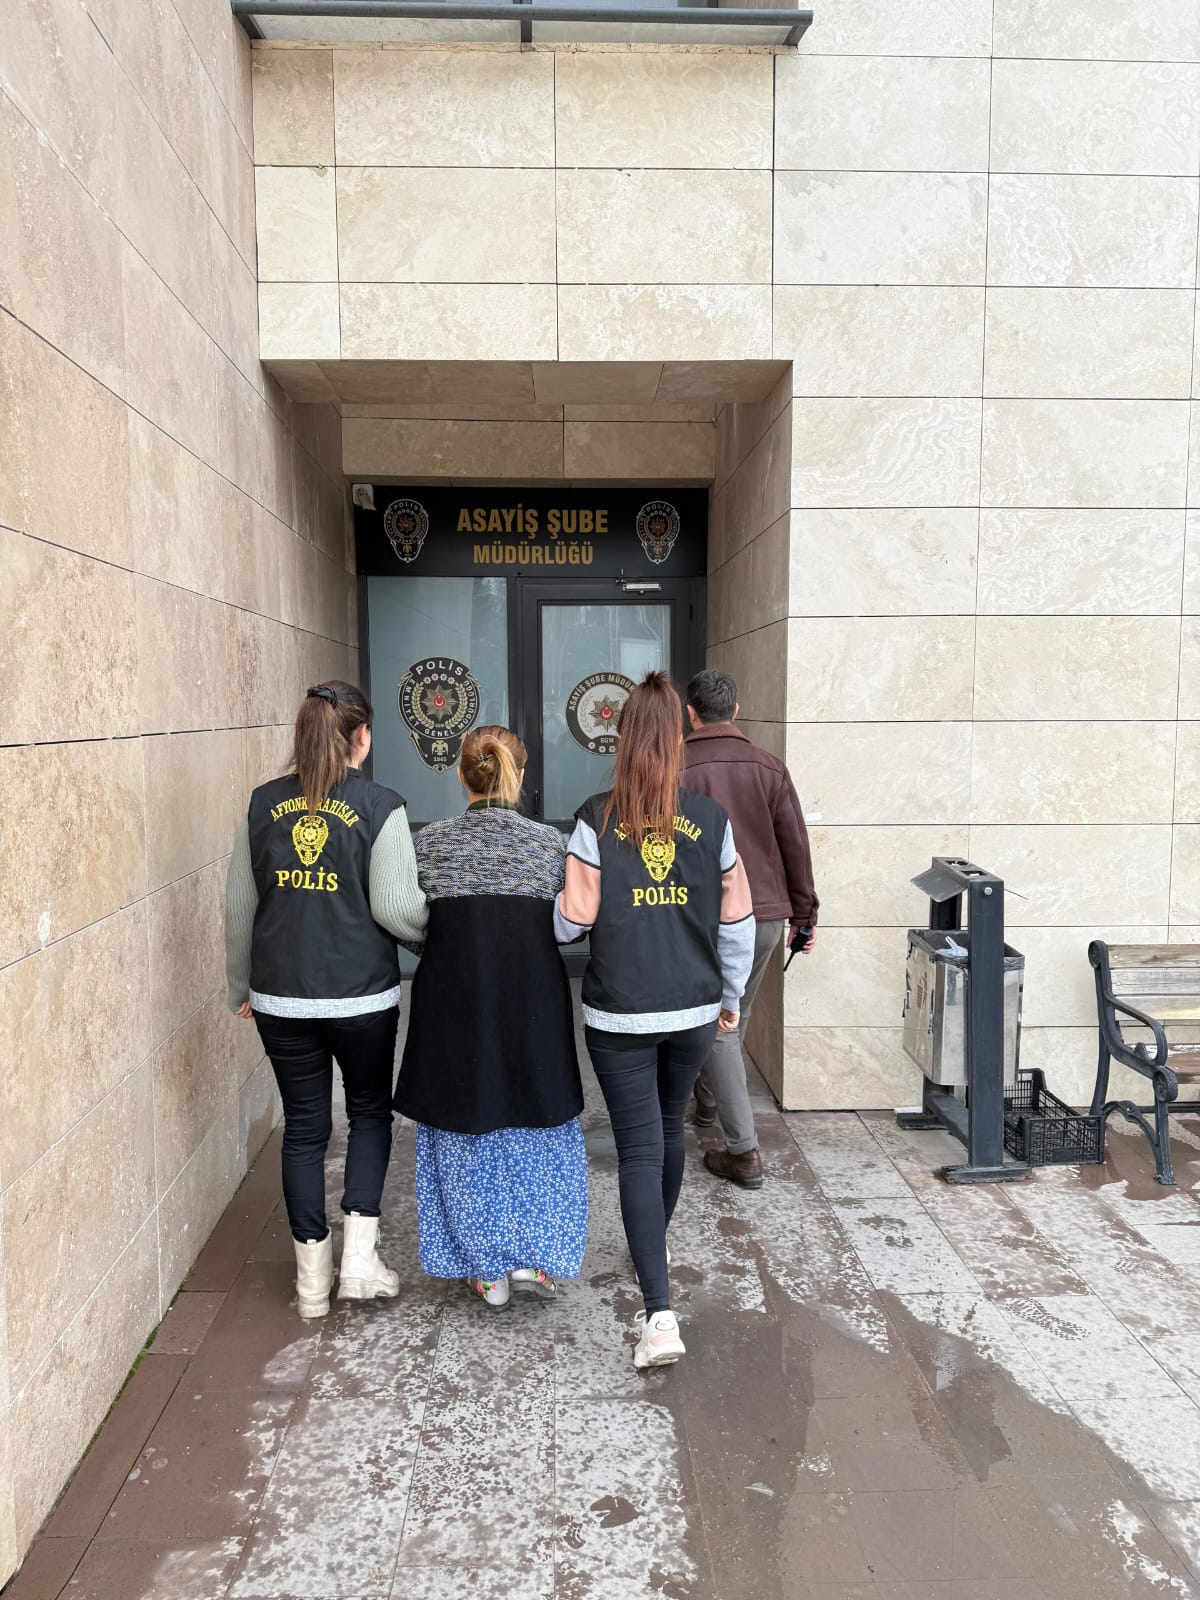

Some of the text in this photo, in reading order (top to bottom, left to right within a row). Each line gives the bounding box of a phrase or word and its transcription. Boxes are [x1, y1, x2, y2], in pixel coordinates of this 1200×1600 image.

[456, 503, 539, 539] ASAYİŞ
[547, 509, 609, 539] ŞUBE
[473, 540, 594, 566] MÜDÜRLÜĞÜ
[415, 660, 464, 676] POLİS
[424, 728, 455, 737] GENEL
[275, 866, 338, 892] POLİS
[632, 880, 688, 907] POLİS
